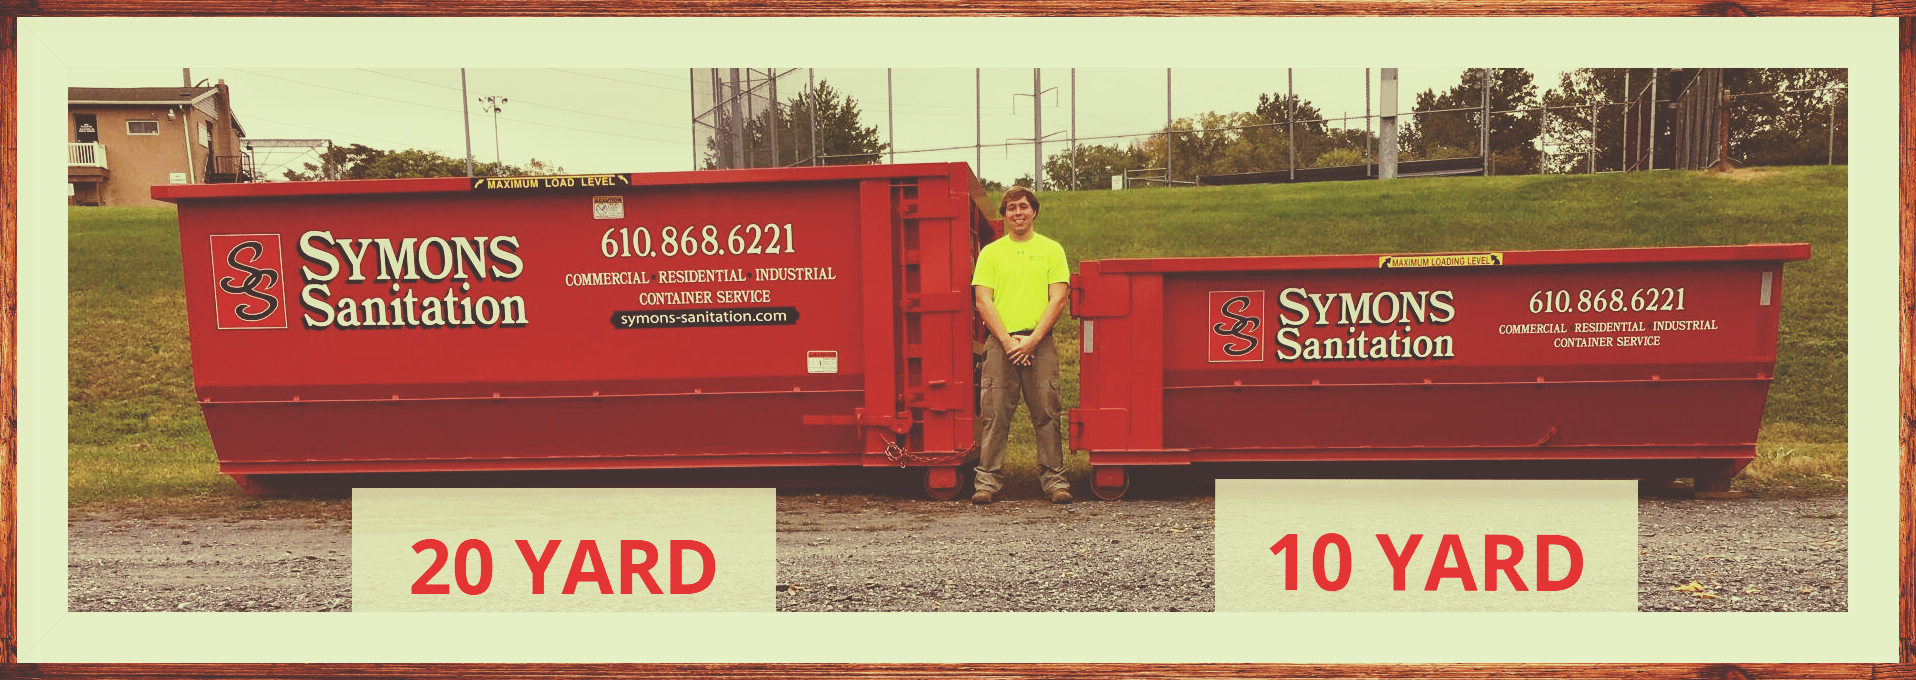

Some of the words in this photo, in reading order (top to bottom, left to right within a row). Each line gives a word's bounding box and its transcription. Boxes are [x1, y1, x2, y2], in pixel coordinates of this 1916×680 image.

[487, 179, 538, 190] MAXIMUM
[545, 178, 574, 188] LOAD
[581, 177, 615, 187] LEVEL
[601, 223, 796, 258] 610.868.6221
[299, 230, 524, 282] SYMONS
[1392, 258, 1429, 267] MAXIMUM
[1431, 257, 1465, 266] LOADING
[1467, 256, 1491, 265] LEVEL
[565, 271, 650, 287] COMMERCIAL
[658, 268, 747, 284] RESIDENTIAL
[755, 267, 836, 282] INDUSTRIAL
[300, 282, 529, 327] Sanitation
[639, 290, 713, 306] CONTAINER
[716, 289, 771, 304] SERVICE
[1279, 287, 1456, 326] SYMONS
[1529, 287, 1685, 314] 610.868.6221
[621, 310, 787, 327] symons-sanitation.com
[1498, 323, 1568, 335] COMMERCIAL
[1574, 321, 1646, 333] RESIDENTIAL
[1652, 320, 1718, 332] INDUSTRIAL
[1276, 325, 1455, 360] Sanitation
[1553, 337, 1613, 348] CONTAINER
[1616, 336, 1661, 347] SERVICE
